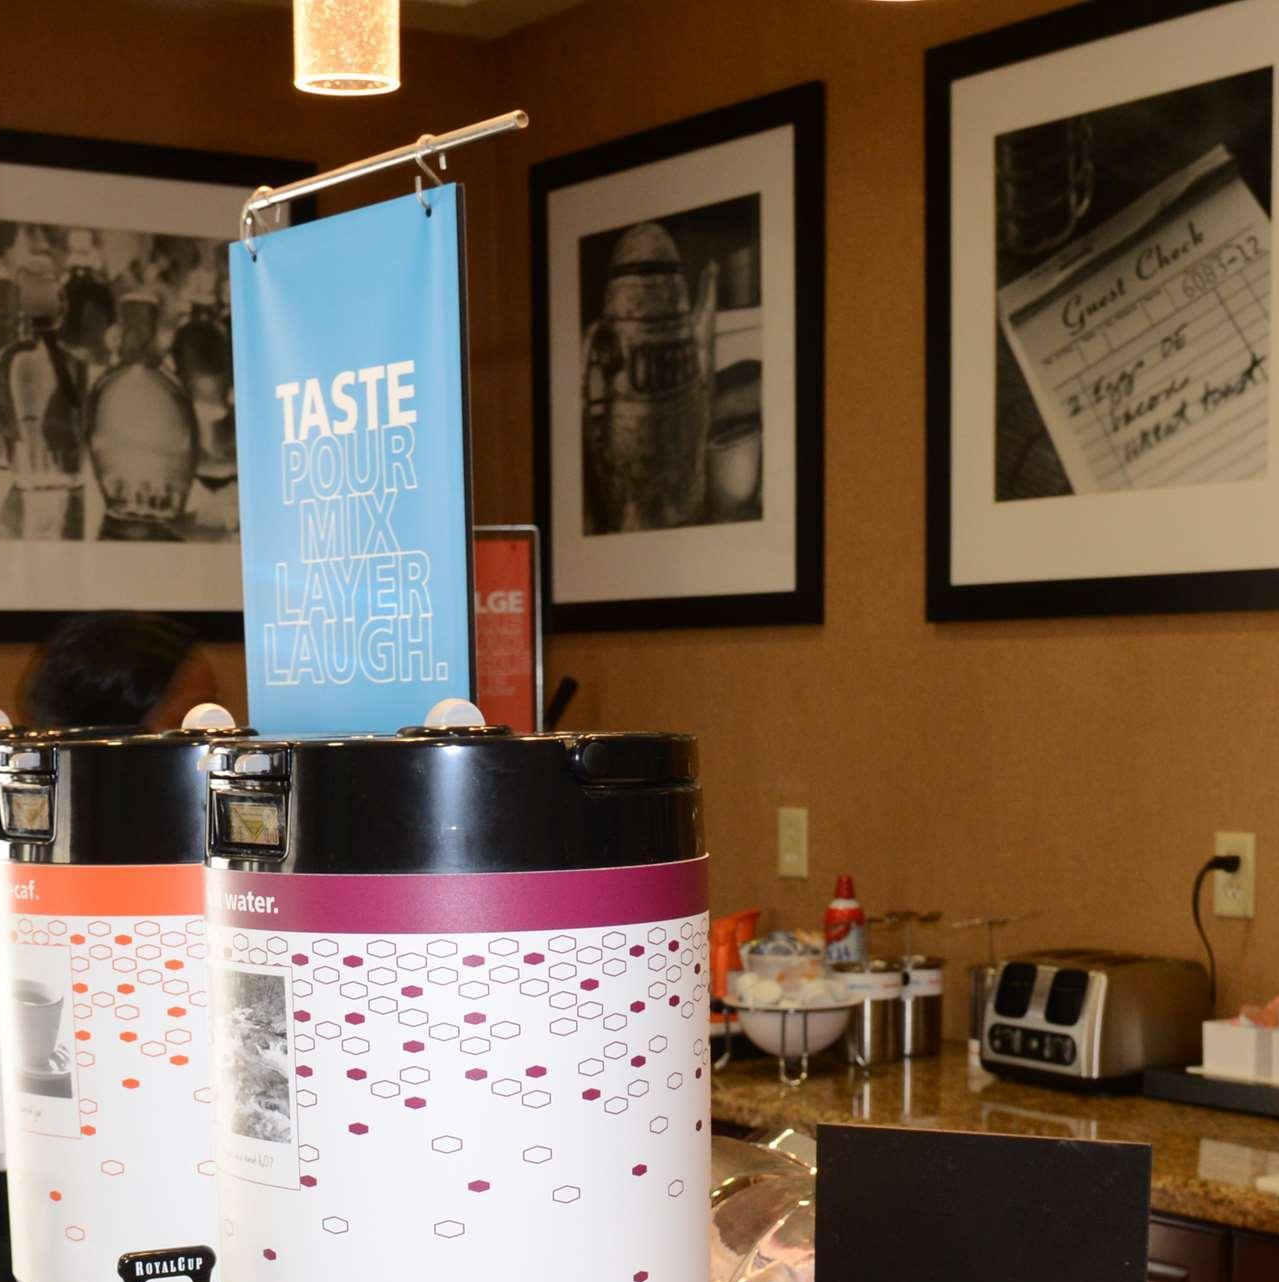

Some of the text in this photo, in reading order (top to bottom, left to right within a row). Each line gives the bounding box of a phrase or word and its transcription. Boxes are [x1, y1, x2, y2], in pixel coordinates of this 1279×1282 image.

[1062, 277, 1126, 335] Guest
[1136, 221, 1203, 281] Check
[276, 361, 417, 441] TASTE
[281, 423, 418, 504] POUR
[300, 490, 399, 563] MIX
[275, 550, 433, 625] LAYER
[264, 614, 448, 684] LAUGH.
[225, 892, 279, 914] water.
